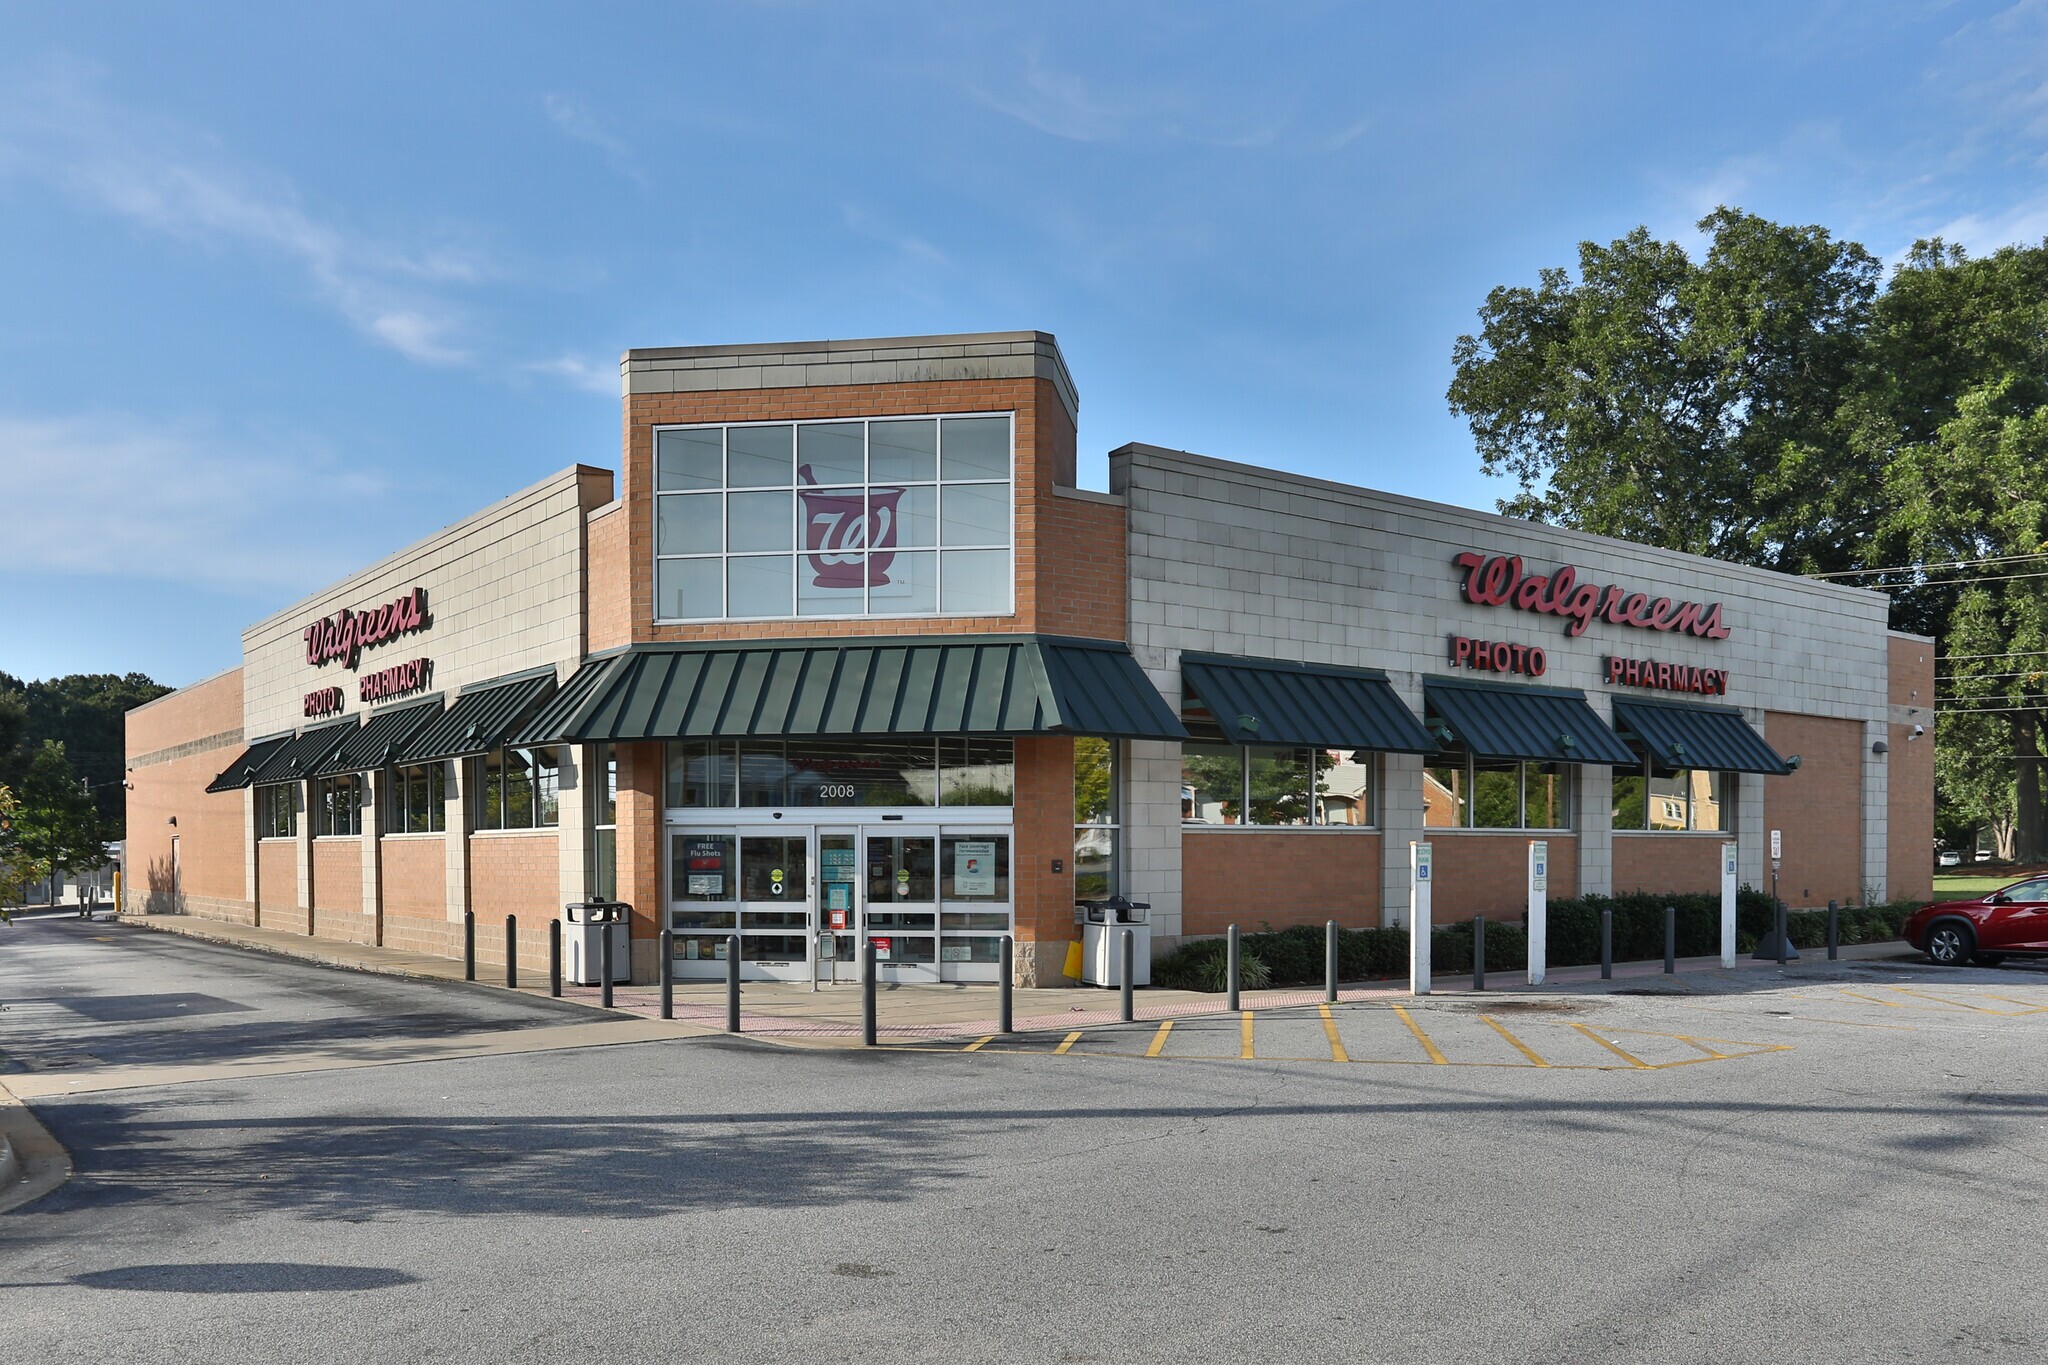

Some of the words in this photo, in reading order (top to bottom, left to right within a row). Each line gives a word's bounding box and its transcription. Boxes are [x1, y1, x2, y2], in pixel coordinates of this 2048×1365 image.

[1456, 551, 1731, 639] Walgreens
[304, 587, 423, 669] Walgreens
[1453, 636, 1546, 676] PHOTO
[1608, 656, 1729, 695] PHARMACY
[360, 658, 426, 701] PHARMACY
[304, 686, 338, 717] PHOTO
[820, 785, 855, 798] 2008
